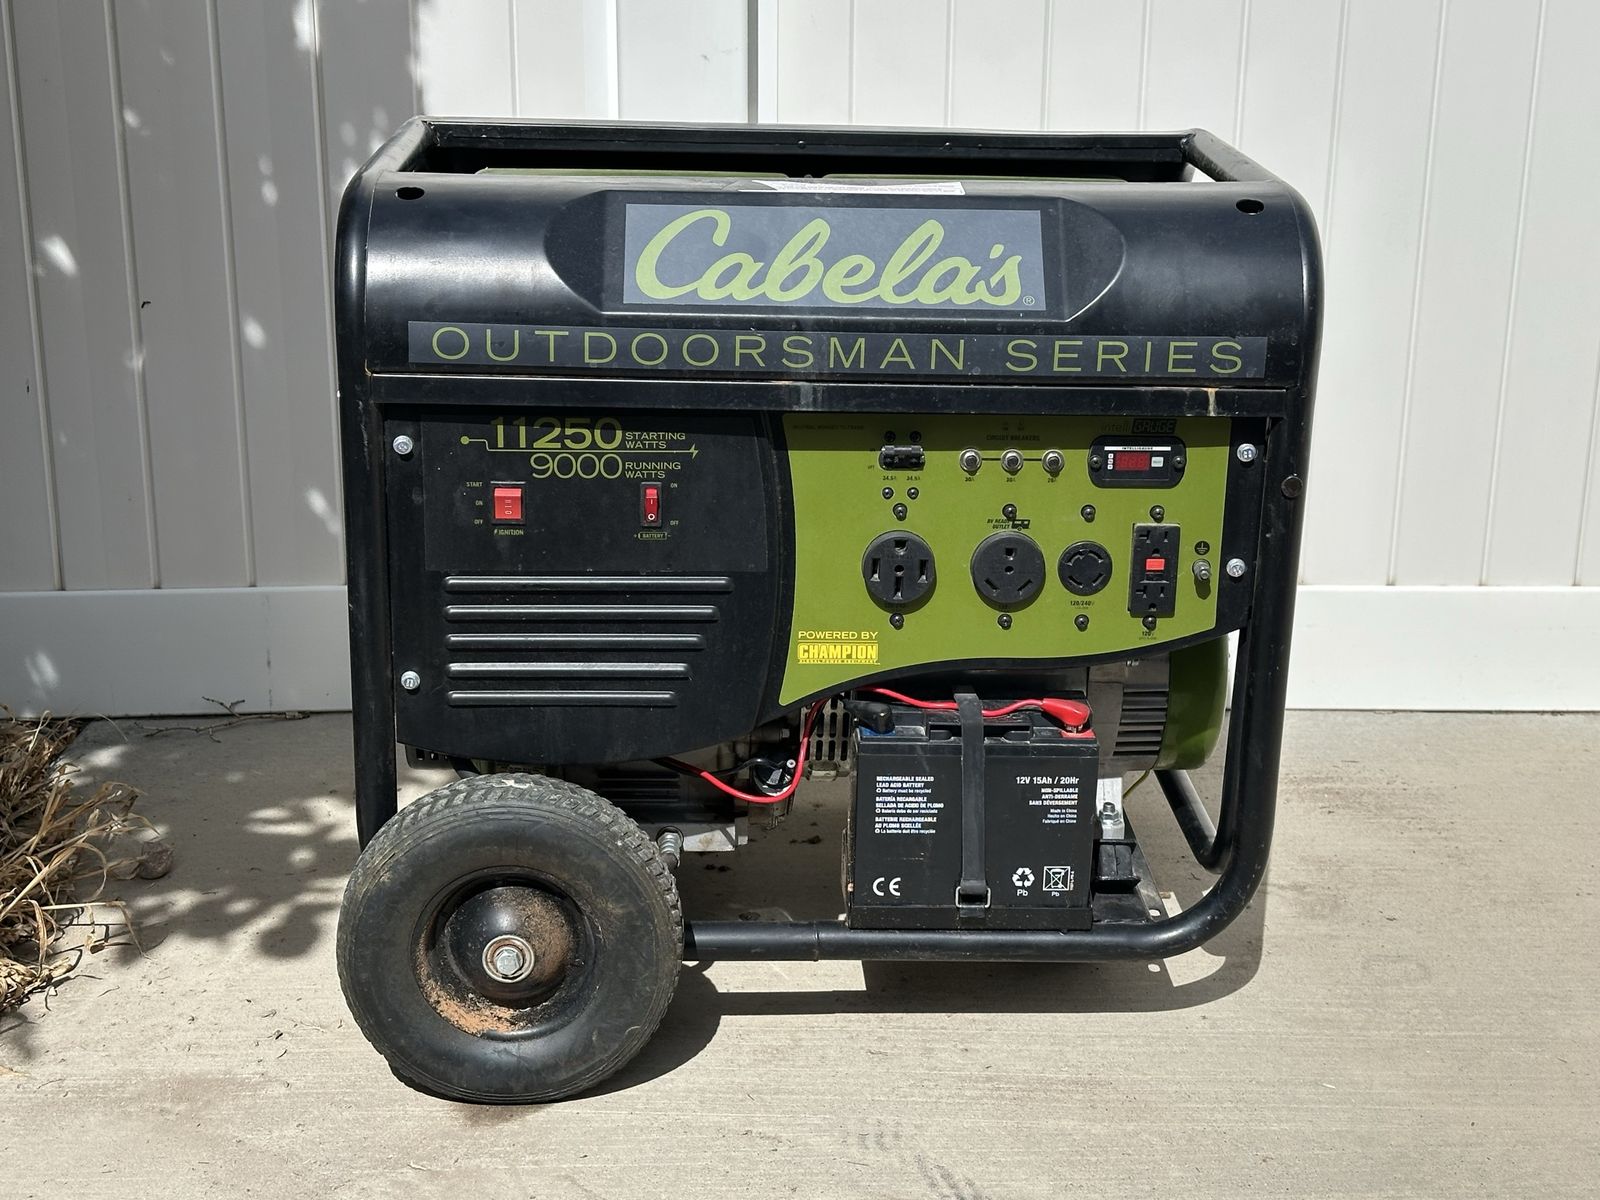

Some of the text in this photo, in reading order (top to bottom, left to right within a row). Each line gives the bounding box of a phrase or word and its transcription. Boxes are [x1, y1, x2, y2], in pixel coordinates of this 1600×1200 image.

[635, 209, 1022, 306] Cabela's
[431, 326, 1244, 375] OUTDOORSMAN SERIES
[490, 416, 623, 450] 11250
[625, 432, 686, 441] STARTING
[625, 441, 667, 449] WATTS
[530, 453, 623, 479] 9000
[625, 461, 681, 470] RUNNING
[625, 470, 666, 479] WATTS
[798, 630, 879, 640] POWERED BY
[798, 643, 878, 659] CHAMPION
[1016, 776, 1080, 785] 12V 15Ah / 20Hr
[872, 877, 902, 897] CE
[1016, 889, 1029, 897] Pb
